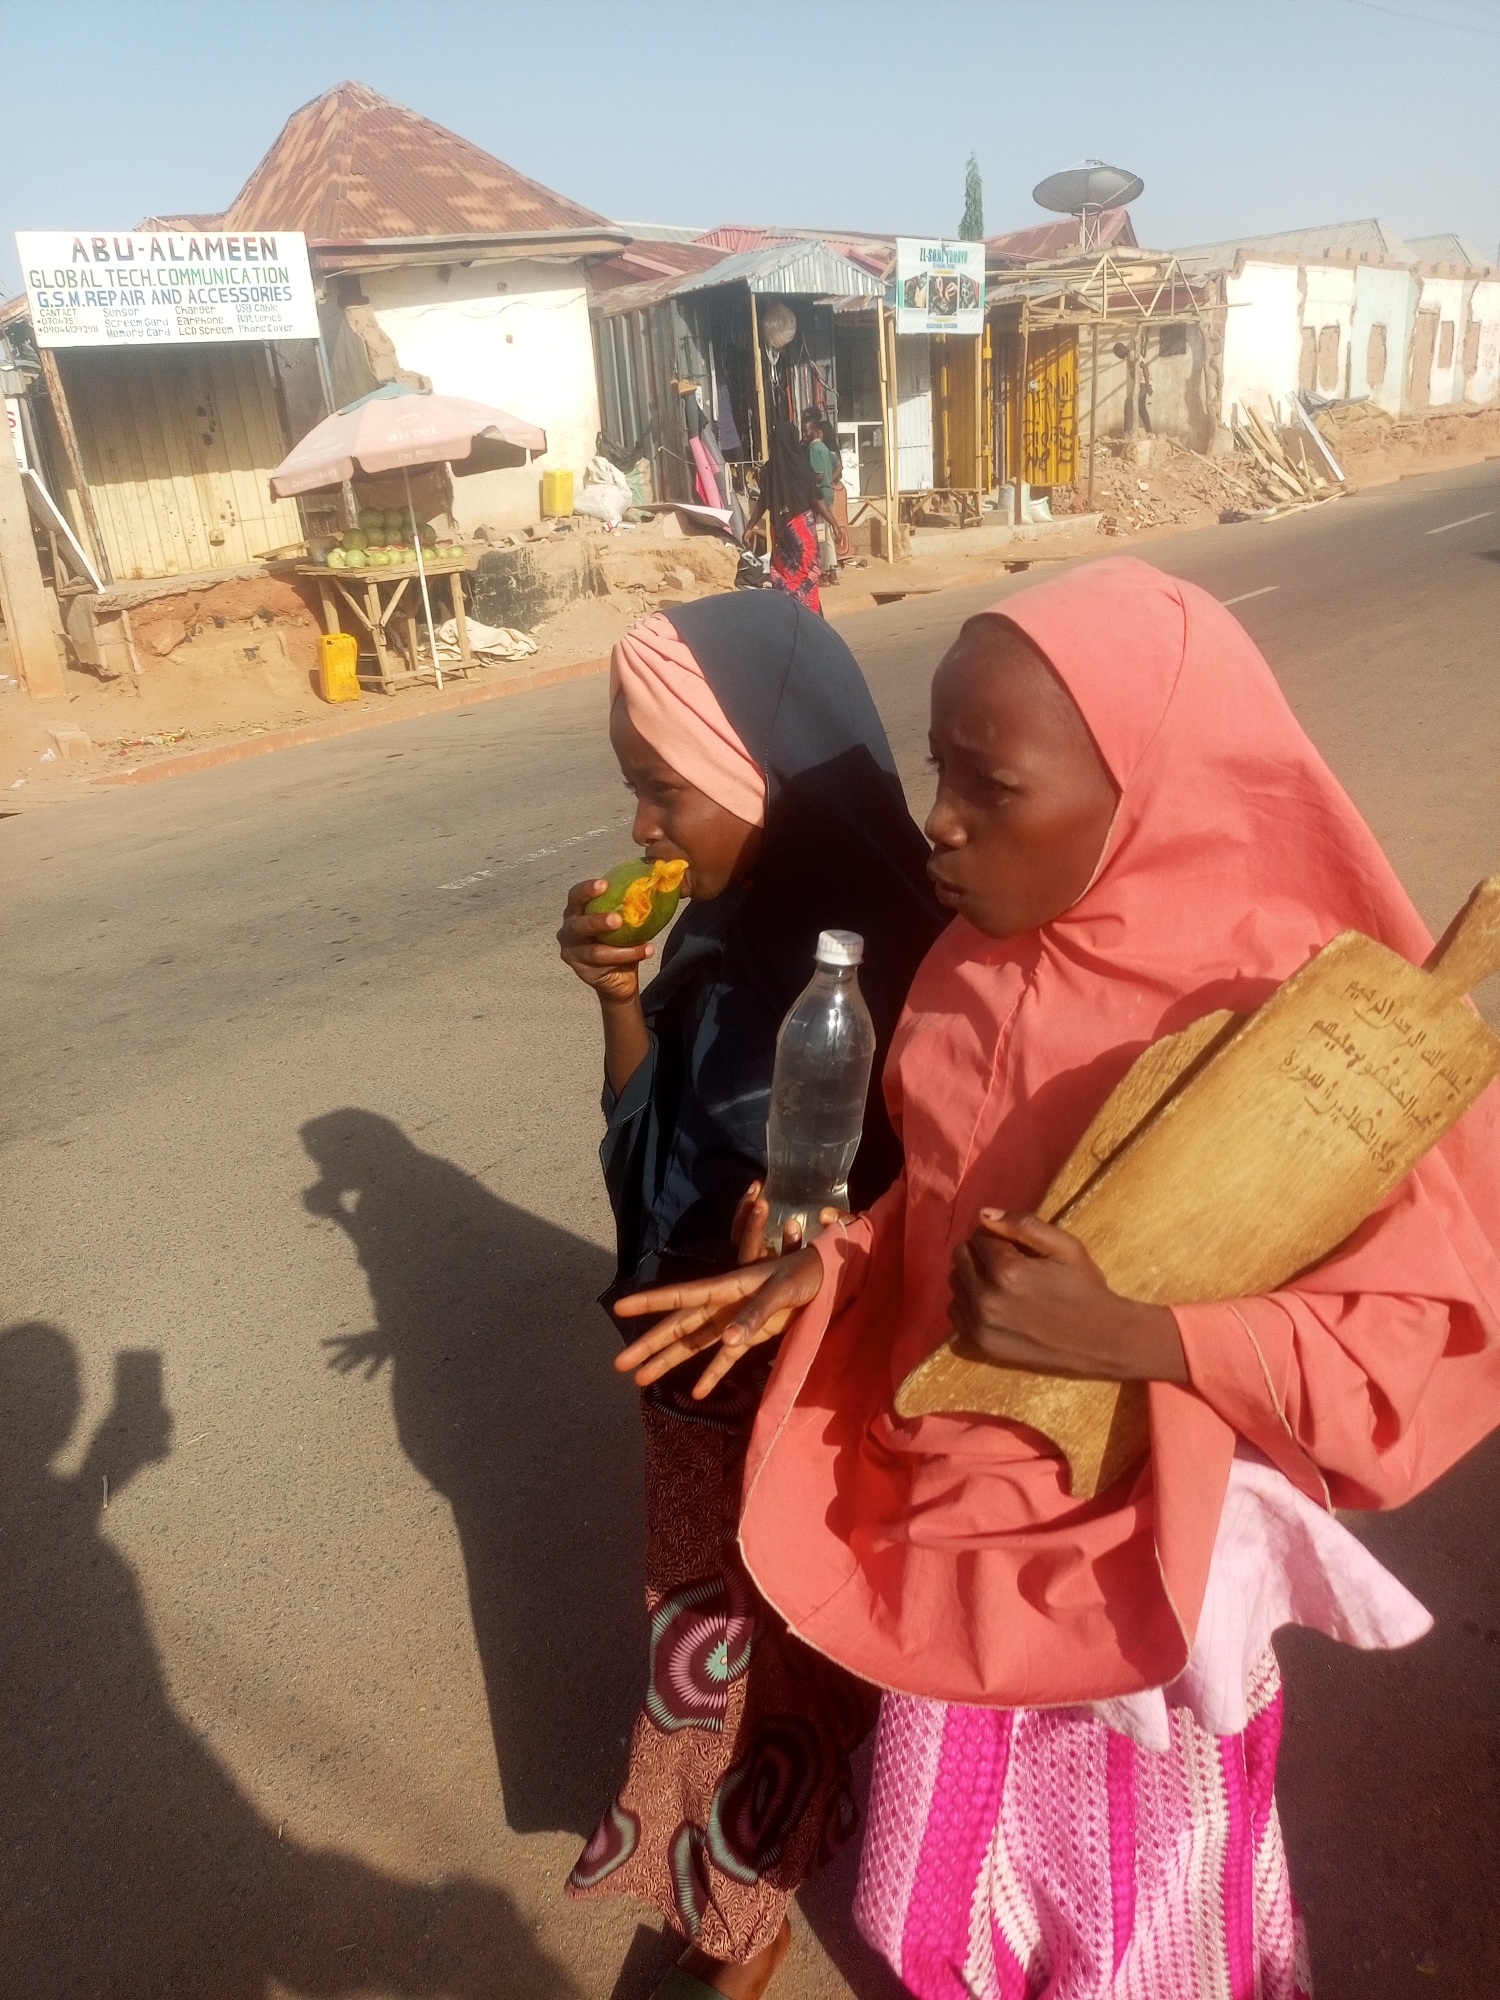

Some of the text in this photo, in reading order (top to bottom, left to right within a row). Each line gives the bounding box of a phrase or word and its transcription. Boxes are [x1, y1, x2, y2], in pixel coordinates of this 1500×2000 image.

[29, 269, 102, 289] GLOBAL
[151, 289, 182, 305] AND
[188, 286, 292, 304] ACCESSORIES
[103, 308, 139, 317] Sensor
[175, 306, 216, 314] Charger
[236, 304, 252, 312] USB
[178, 327, 196, 335] LCD
[239, 324, 293, 333] Phone Cover
[106, 329, 171, 338] Memory Card
[387, 425, 439, 443] airtel
[398, 448, 433, 460] Pay Bills
